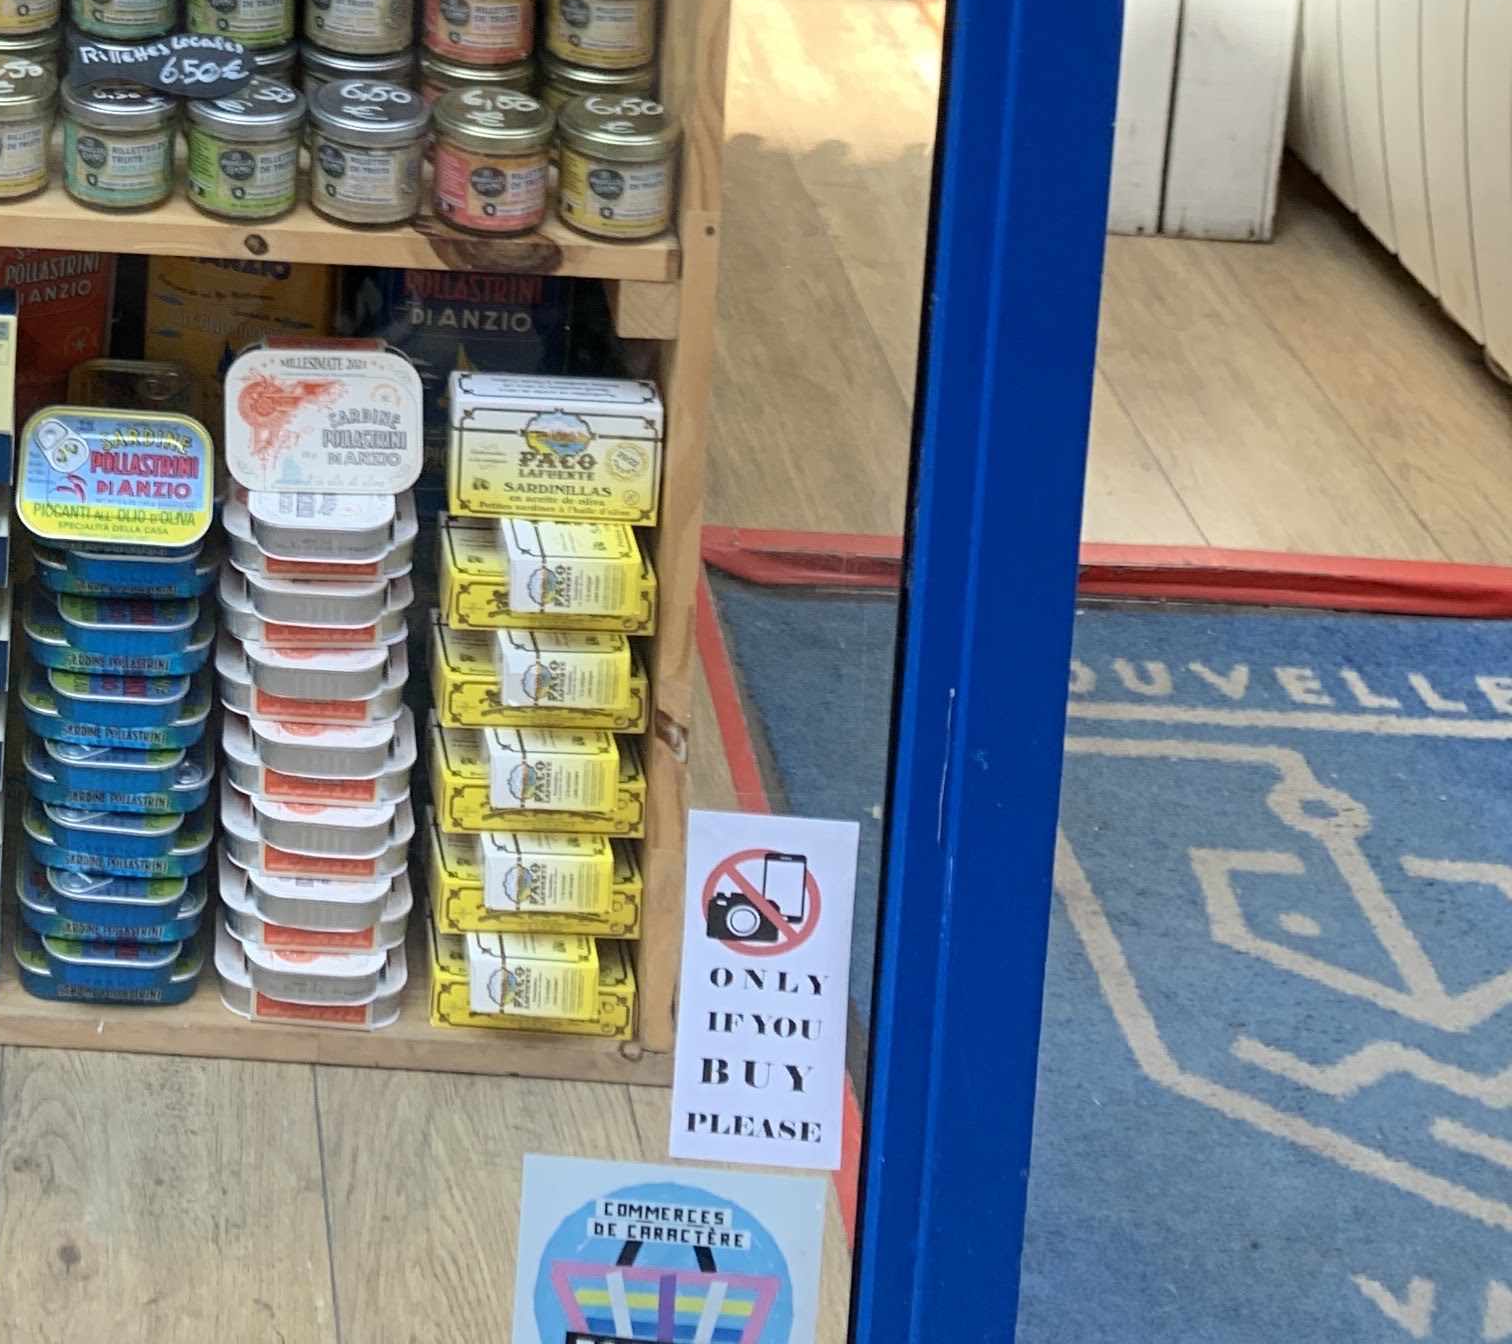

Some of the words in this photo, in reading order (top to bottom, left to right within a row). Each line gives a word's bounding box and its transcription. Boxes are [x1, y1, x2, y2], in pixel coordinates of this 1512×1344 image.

[79, 43, 170, 66] Rillettes
[5, 252, 100, 287] POLLASTRINI
[29, 280, 93, 303] ANZIO
[436, 310, 533, 333] ANZIO
[328, 408, 401, 429] SARDINE
[99, 427, 193, 454] SARDINE
[323, 428, 407, 450] POLLASTRINI
[90, 451, 200, 479] POLLASTRINI
[343, 452, 402, 466] ANZIO
[518, 451, 598, 471] PACO
[518, 469, 596, 481] LAFUENTE
[96, 480, 113, 495] DI
[117, 479, 192, 500] ANZIO
[504, 481, 613, 498] SARDINILLAS
[144, 527, 169, 535] CASA
[554, 564, 566, 608] PACO
[66, 654, 107, 669] SARDINE
[109, 656, 170, 672] POLLASTRINI
[62, 724, 102, 738] SARDINE
[106, 726, 166, 744] POLLASTRINI
[66, 789, 107, 804] SARDINE
[110, 792, 171, 809] POLLASTRINI
[64, 854, 106, 869] SARDINE
[108, 856, 169, 874] POLLASTRINI
[709, 967, 831, 997] ONLY
[706, 1011, 744, 1035] IF
[748, 1012, 823, 1042] YOU
[698, 1057, 816, 1094] BUY
[685, 1112, 823, 1144] PLEASE
[603, 1201, 726, 1227] COMMERCES
[593, 1222, 617, 1238] DE
[627, 1223, 745, 1249] CARACTÈRE
